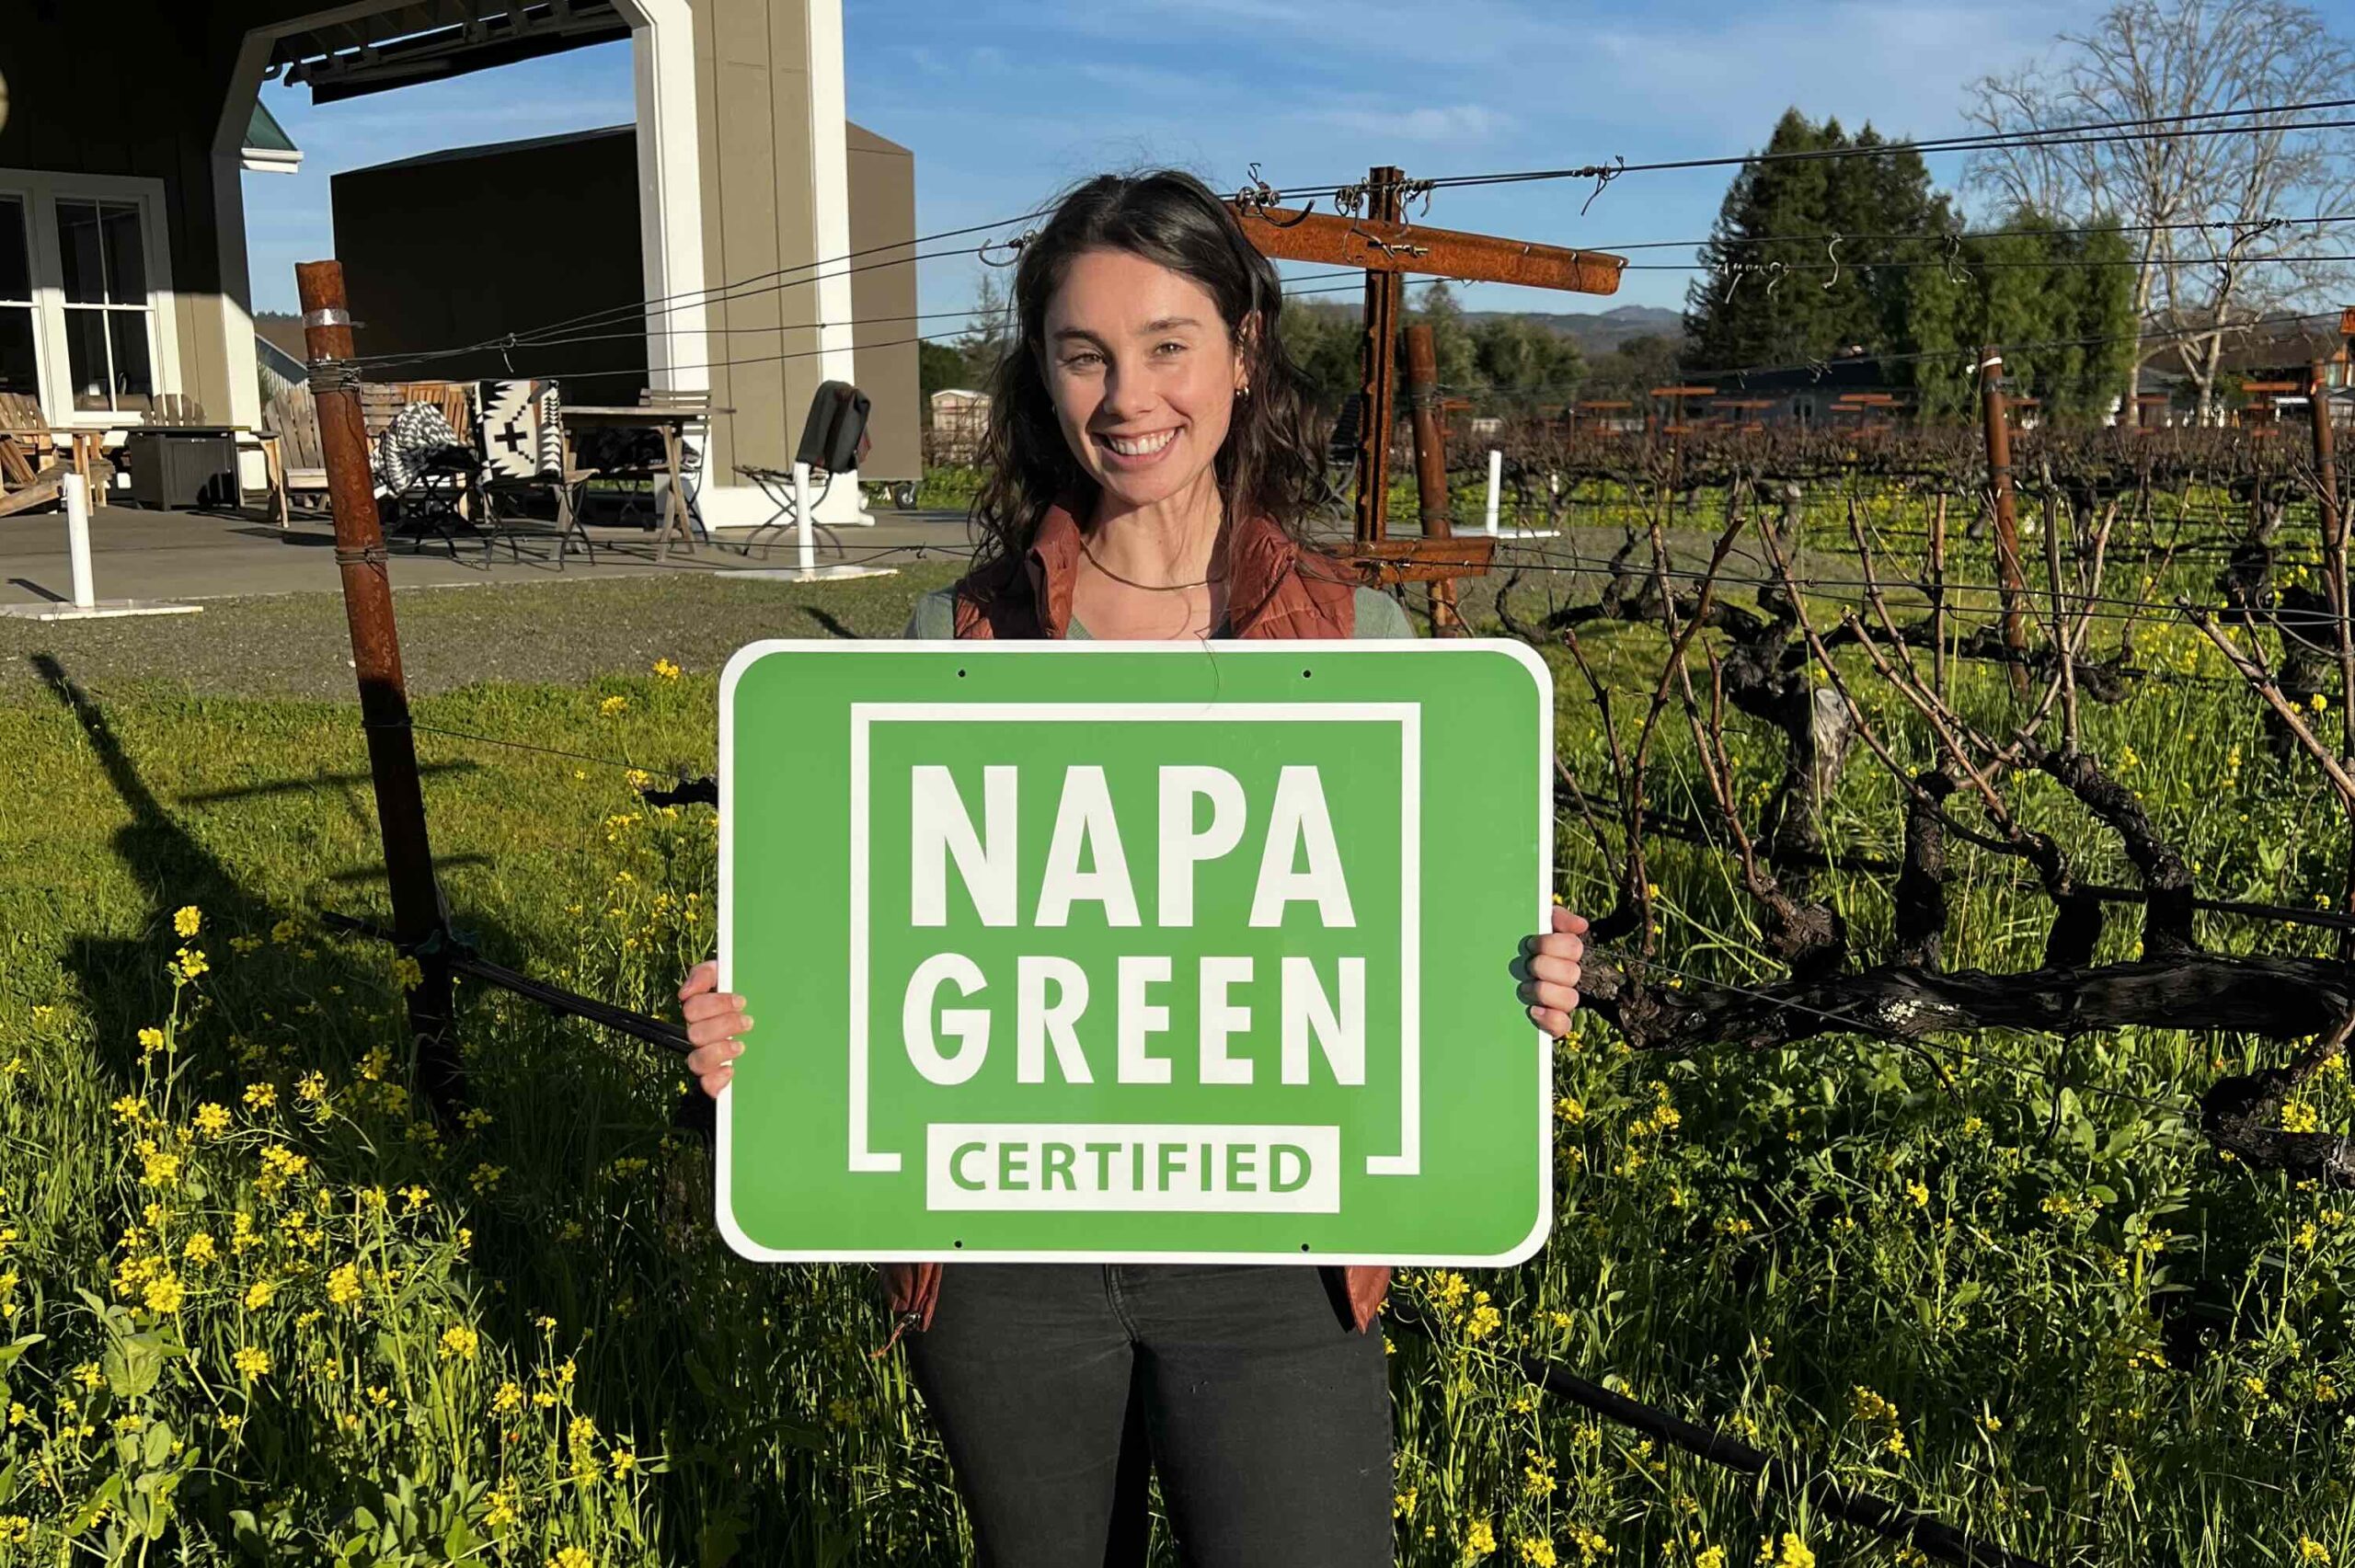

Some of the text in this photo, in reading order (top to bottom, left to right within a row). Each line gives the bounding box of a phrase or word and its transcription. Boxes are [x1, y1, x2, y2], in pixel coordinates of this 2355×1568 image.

[912, 765, 1356, 927] NAPA
[903, 953, 1365, 1085] GREEN
[950, 1142, 1311, 1192] CERTIFIED
